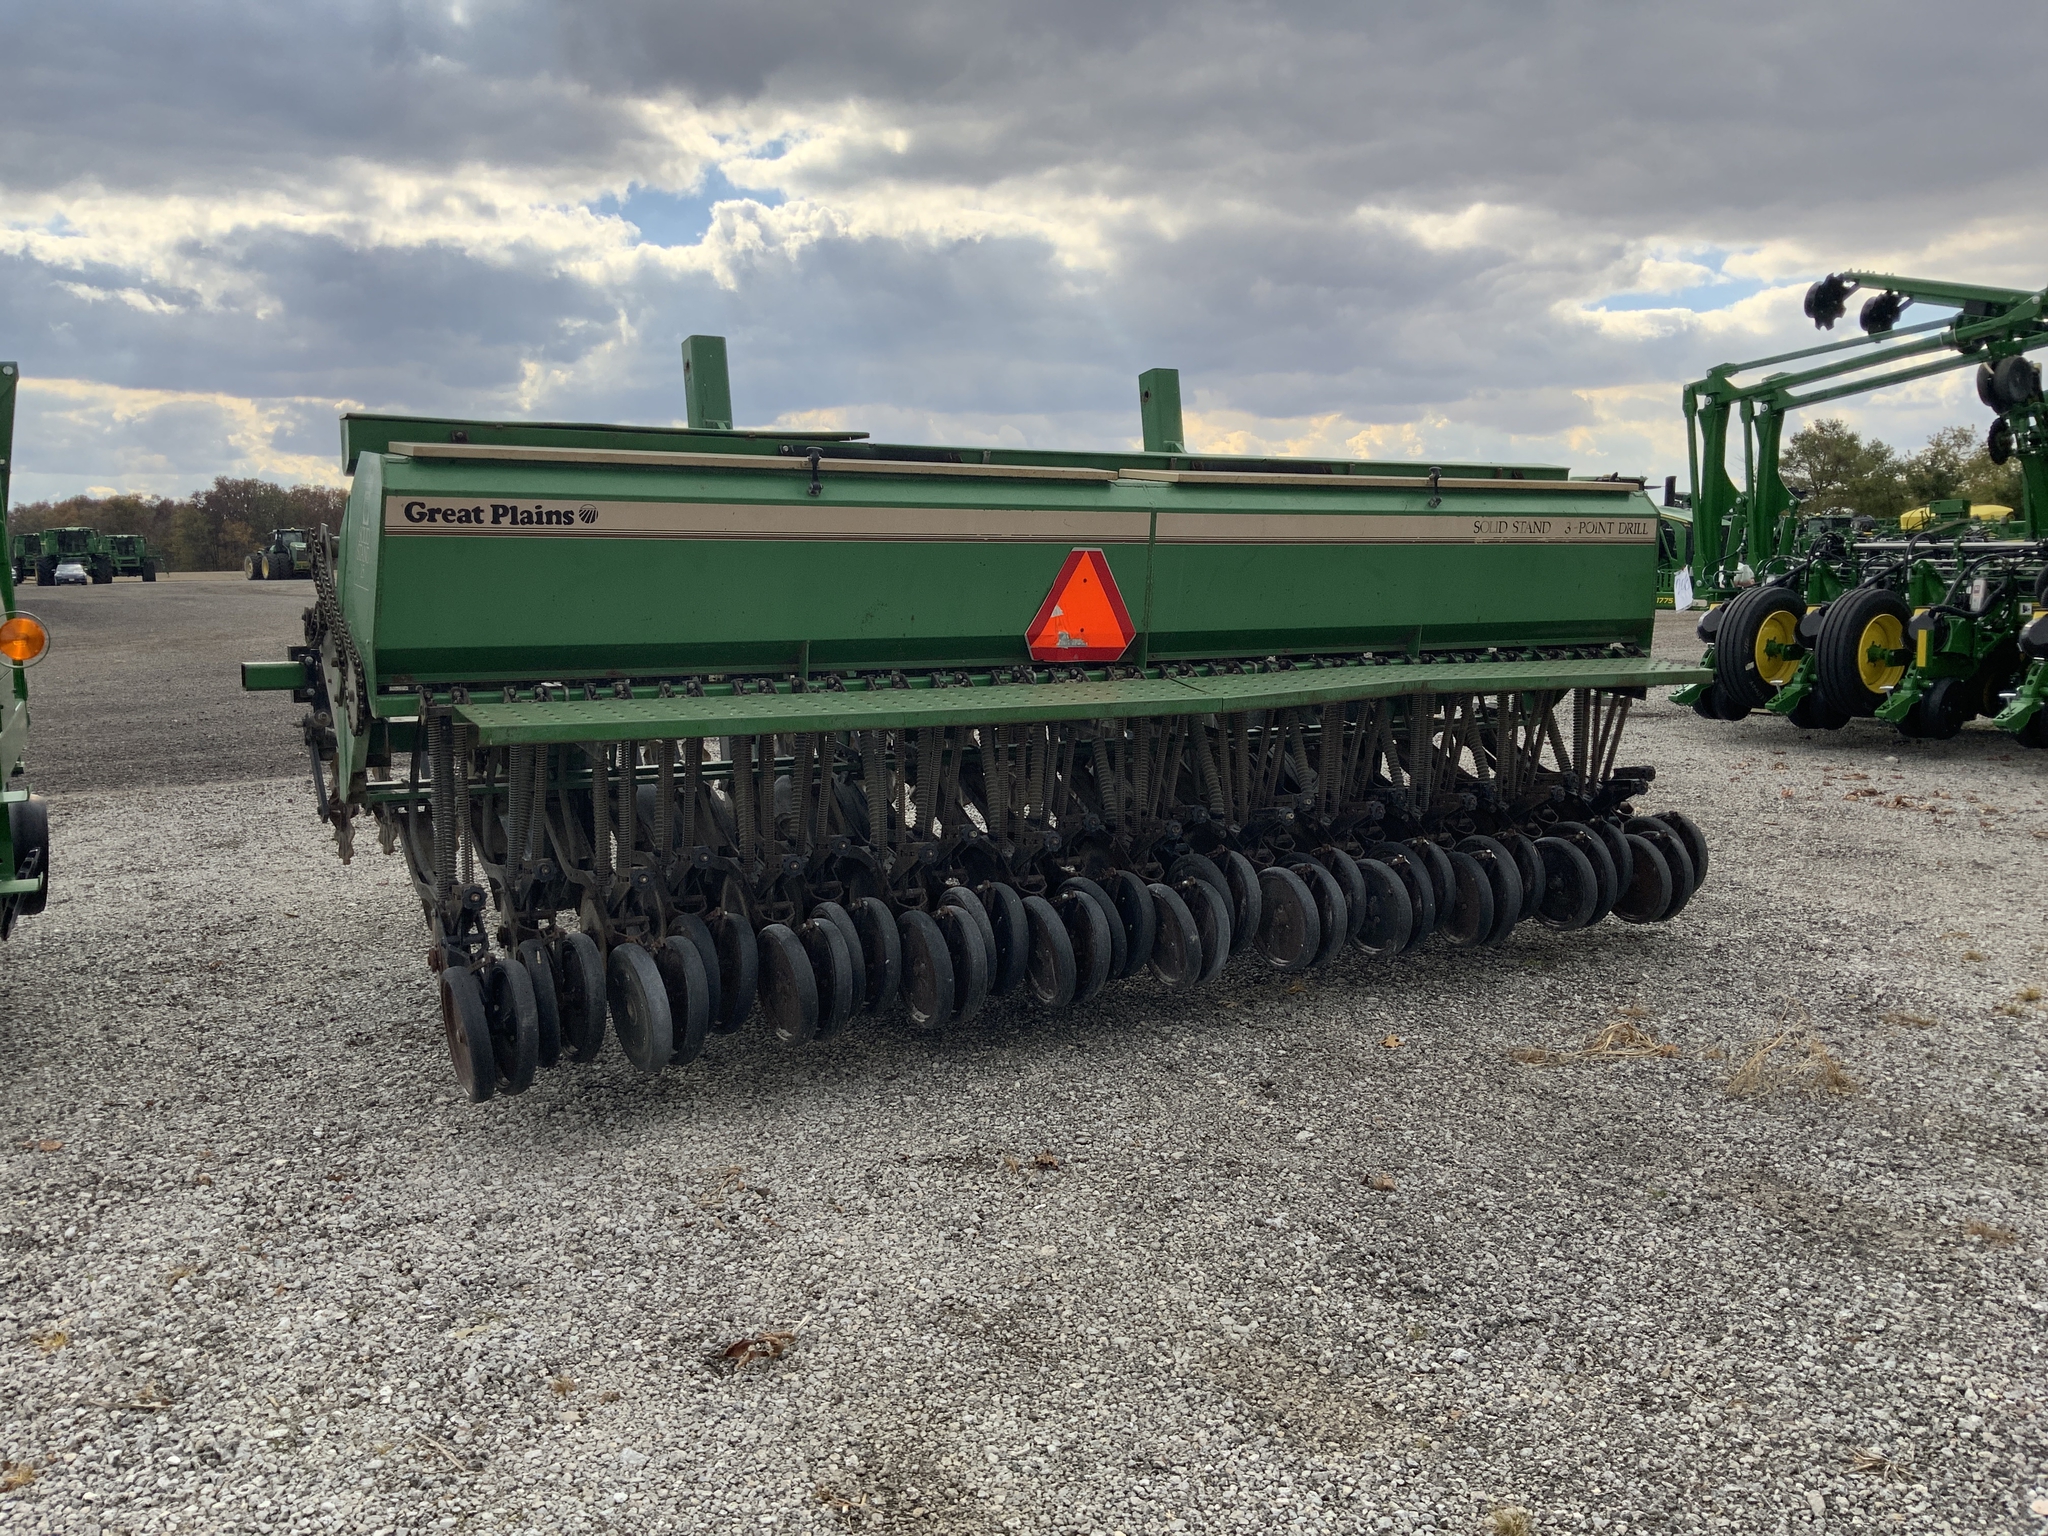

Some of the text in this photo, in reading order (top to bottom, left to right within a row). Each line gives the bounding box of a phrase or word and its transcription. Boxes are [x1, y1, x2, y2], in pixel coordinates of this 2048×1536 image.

[404, 501, 575, 526] Great Plains
[1473, 520, 1508, 534] SOLID
[1512, 521, 1552, 534] STAND
[1618, 522, 1649, 535] DRILL
